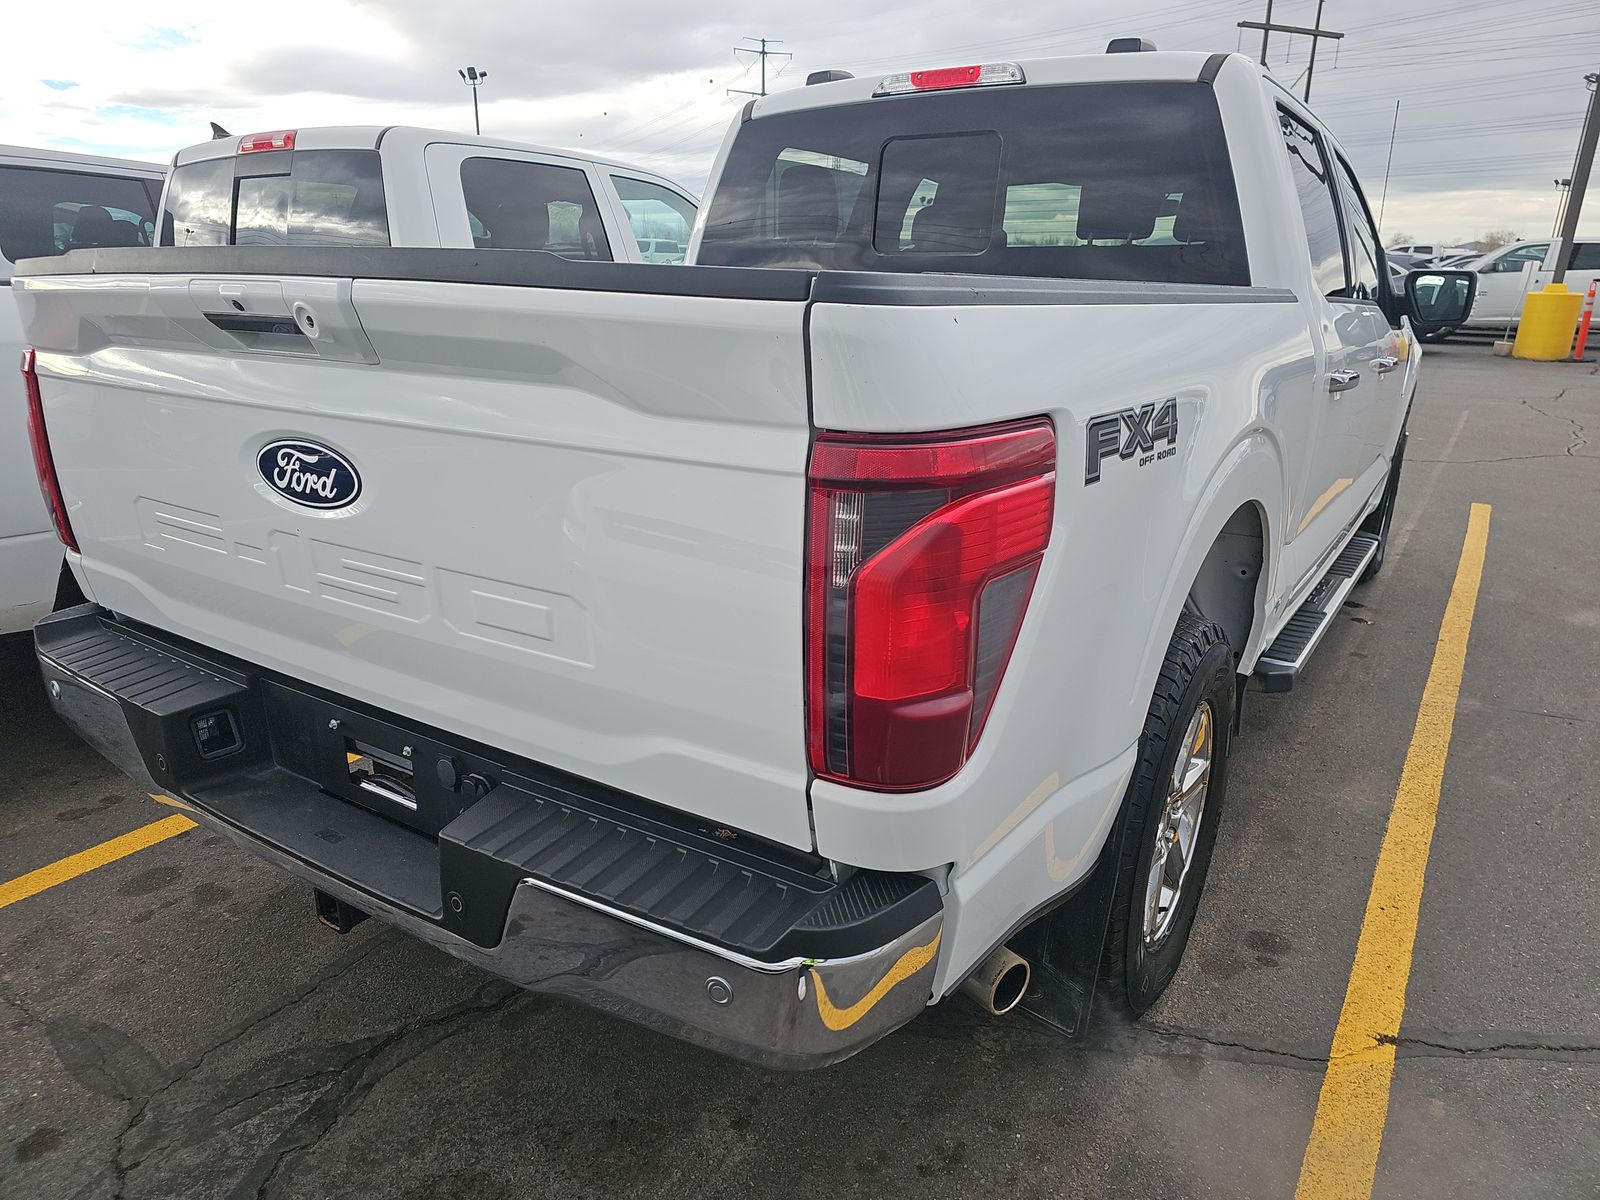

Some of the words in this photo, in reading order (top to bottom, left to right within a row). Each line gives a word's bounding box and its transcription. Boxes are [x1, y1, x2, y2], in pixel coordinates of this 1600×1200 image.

[273, 447, 338, 499] Ford
[1084, 396, 1178, 486] FX4
[1139, 454, 1155, 467] OFF
[1156, 447, 1177, 462] ROAD
[134, 495, 595, 669] F-150
